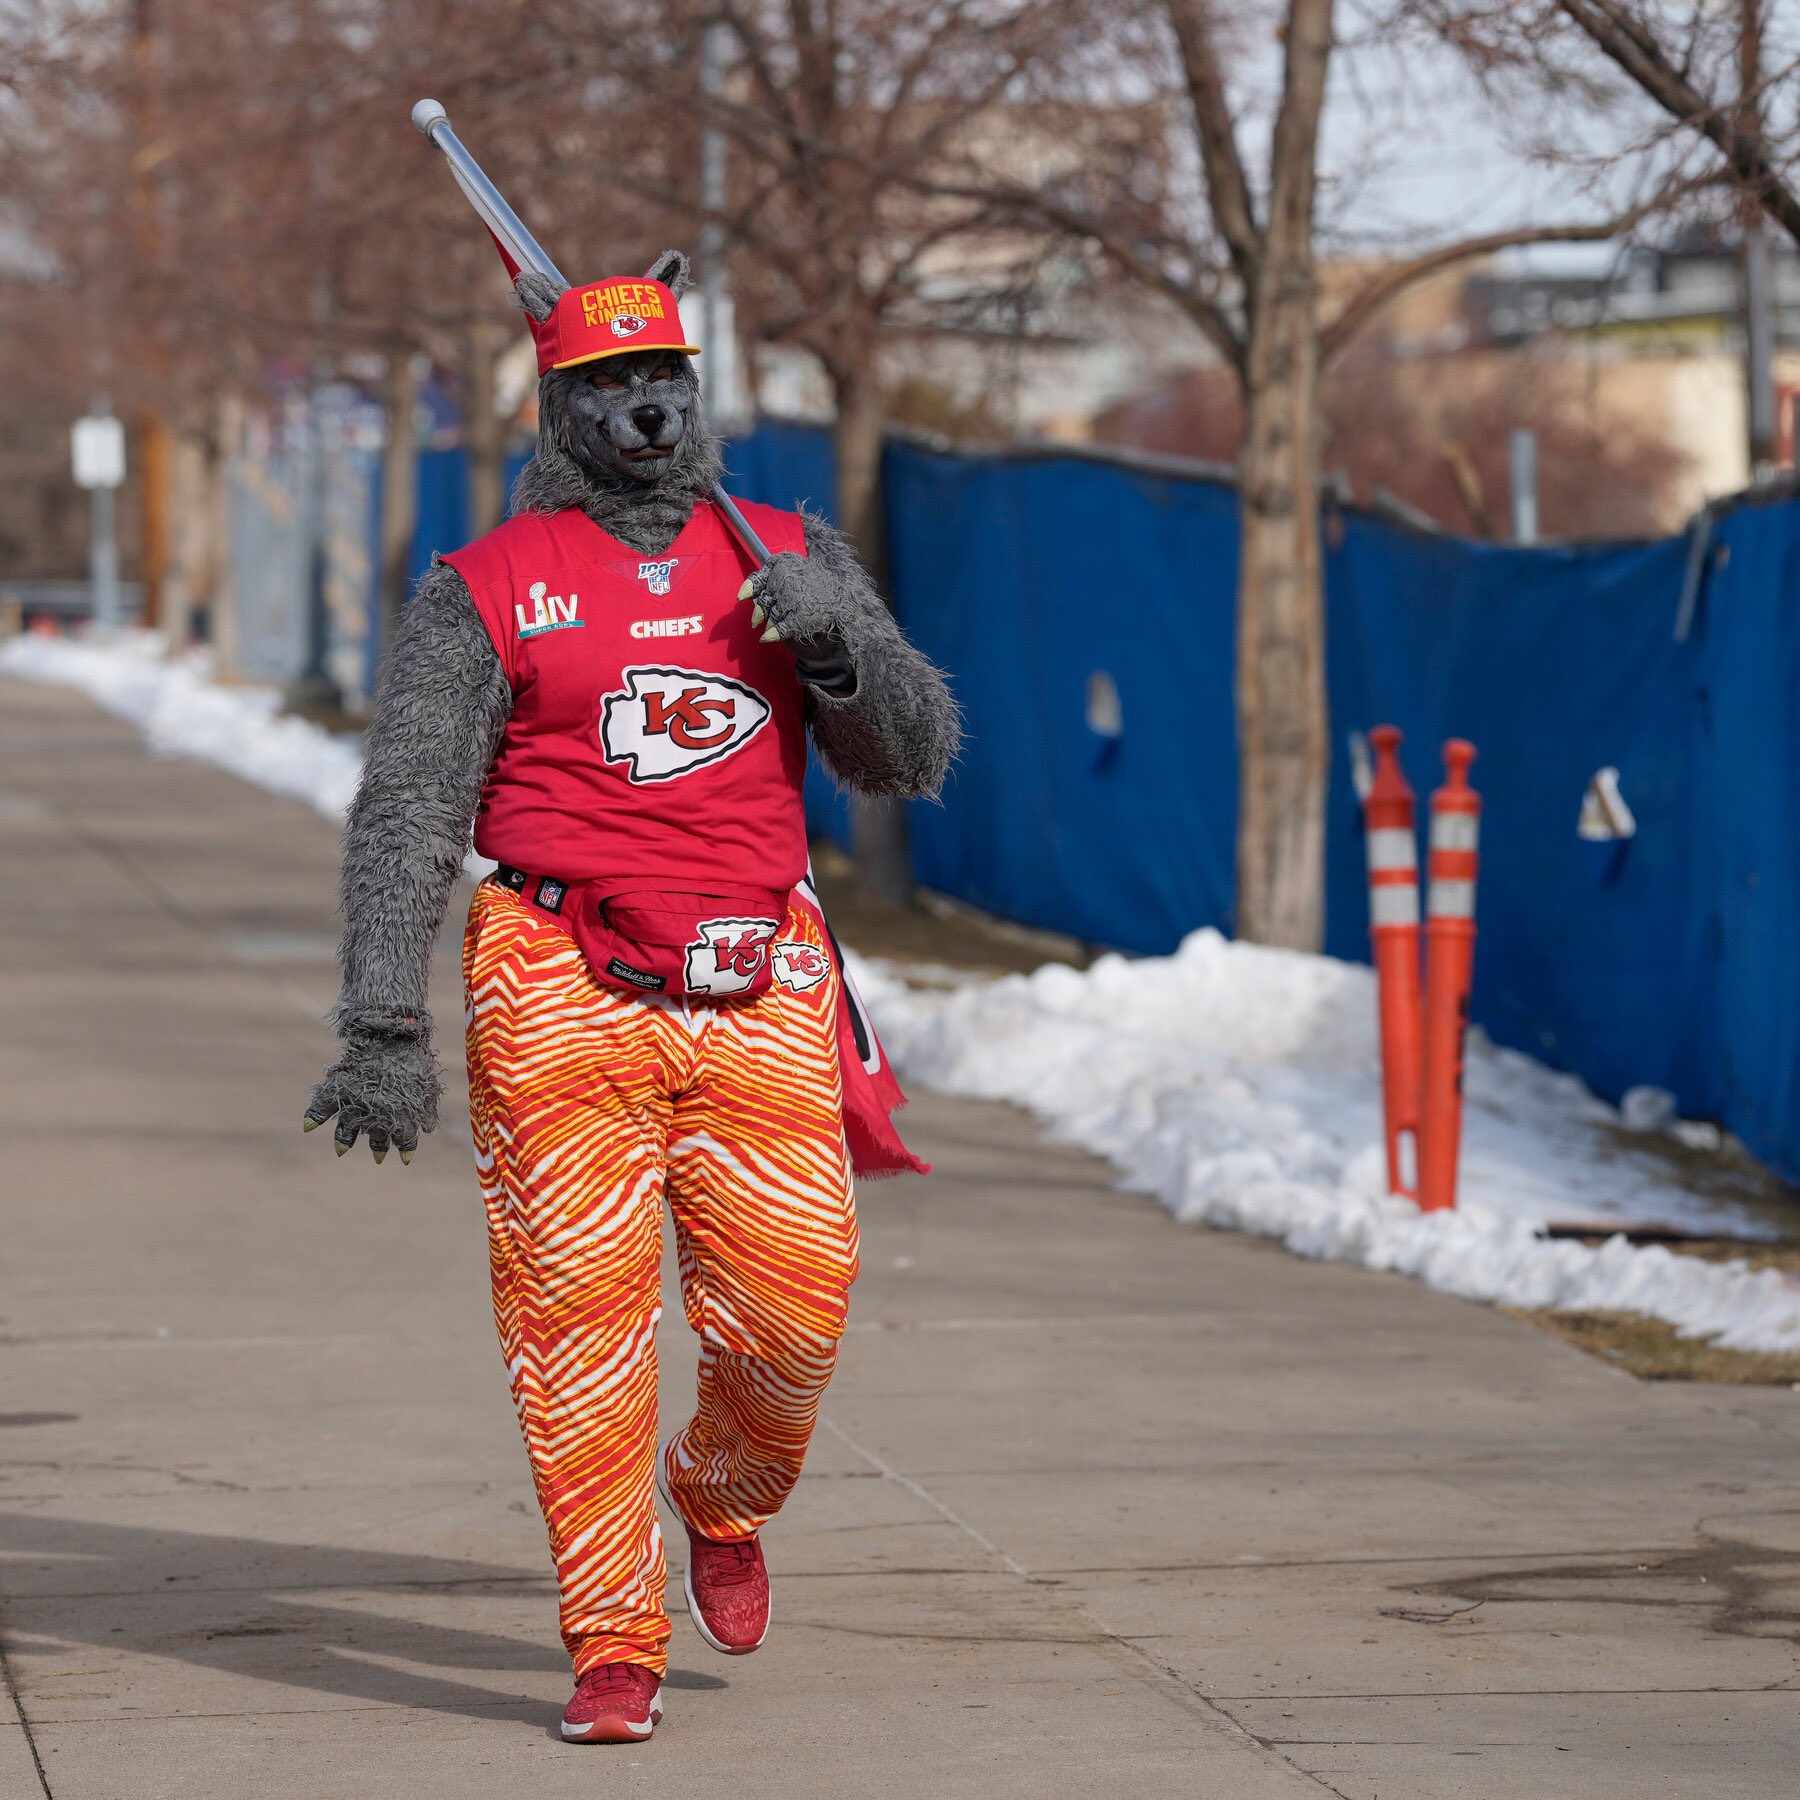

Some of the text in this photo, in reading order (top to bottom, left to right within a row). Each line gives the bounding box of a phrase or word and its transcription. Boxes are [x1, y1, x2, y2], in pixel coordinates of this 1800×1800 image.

[580, 284, 660, 312] CHIEFS
[584, 303, 664, 327] KINGDOM
[651, 582, 669, 592] NFL
[515, 594, 578, 632] LIV
[529, 622, 573, 635] SUPER BOWL
[630, 616, 704, 639] CHIEFS
[641, 686, 737, 750] KC
[542, 890, 556, 906] NFL
[612, 965, 640, 979] Mitchell
[783, 948, 824, 977] KC
